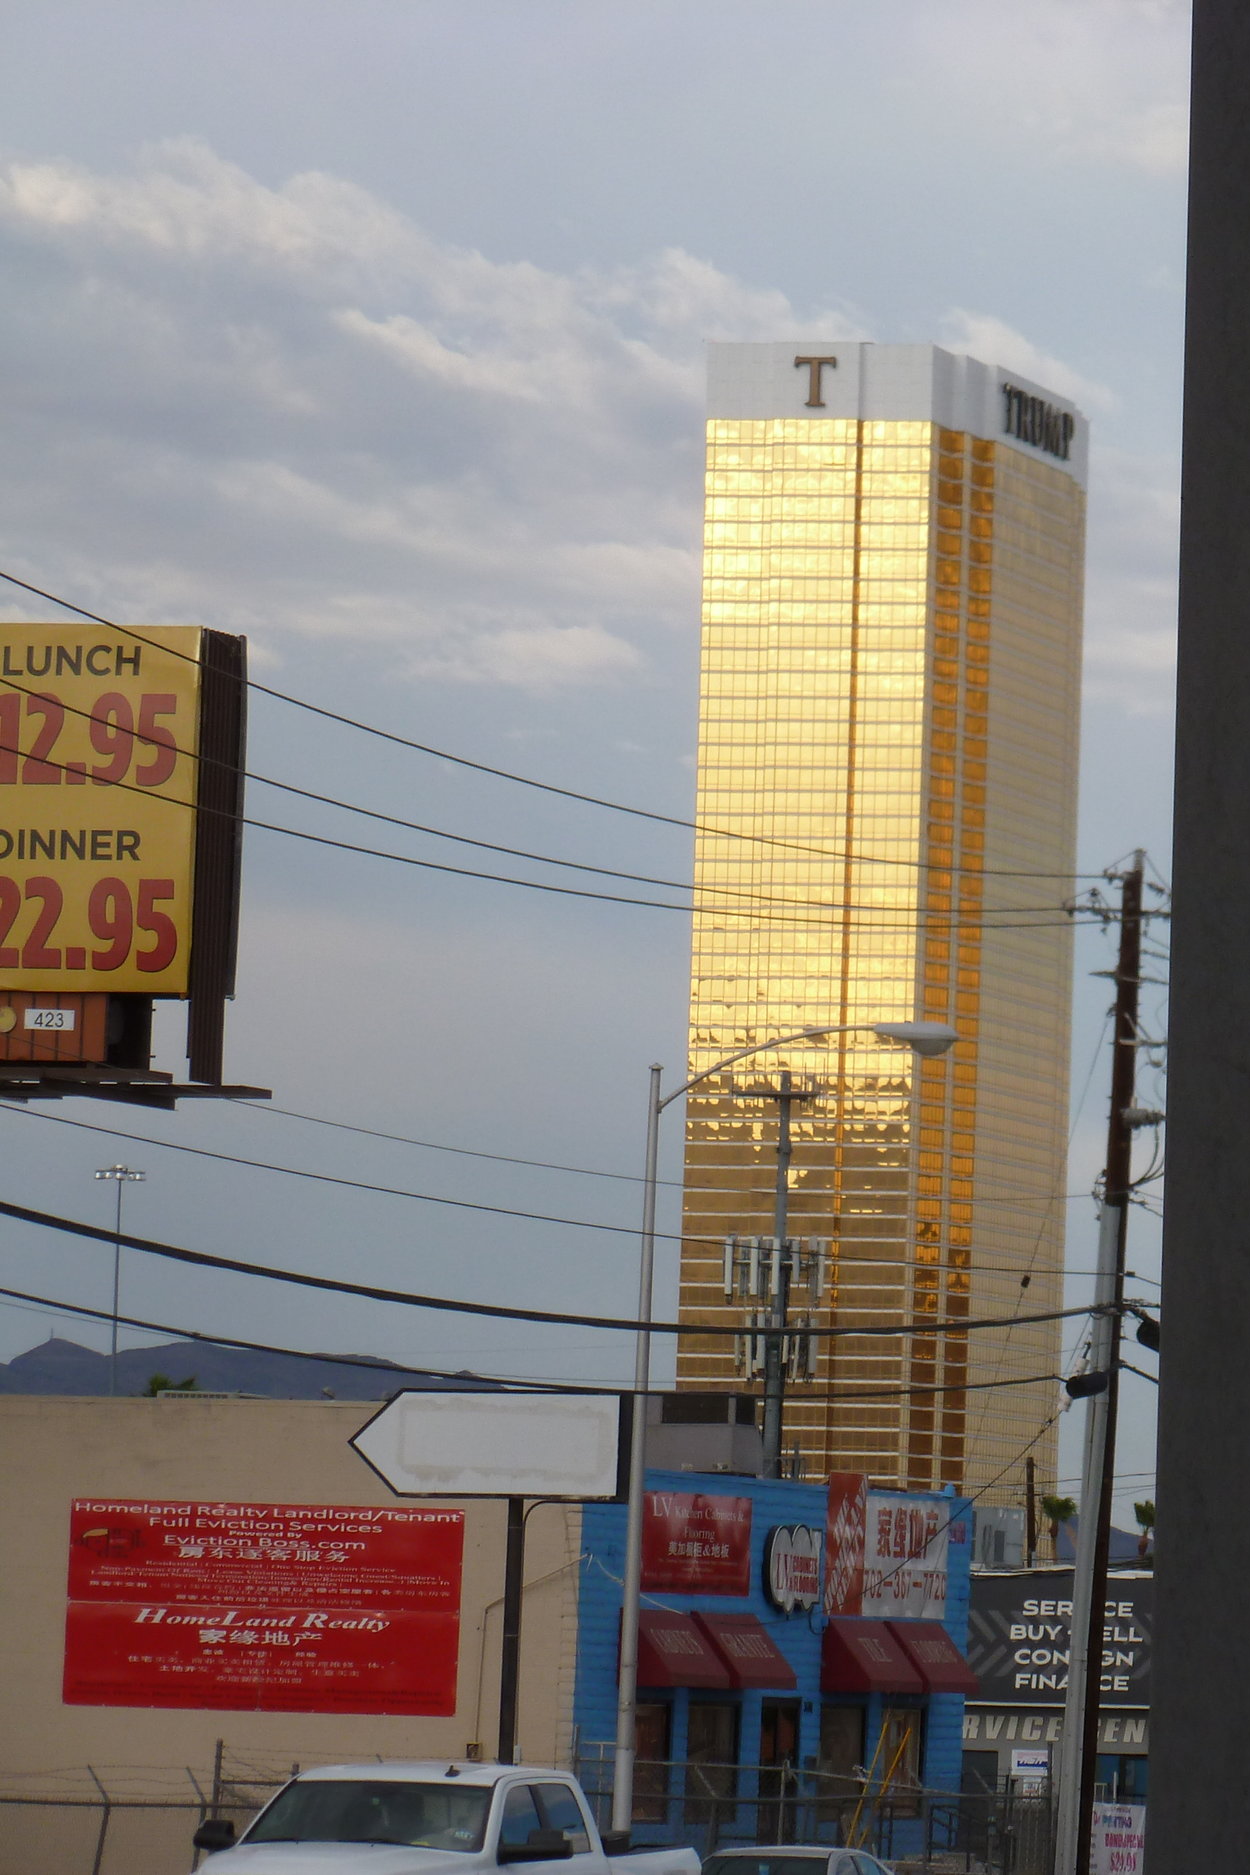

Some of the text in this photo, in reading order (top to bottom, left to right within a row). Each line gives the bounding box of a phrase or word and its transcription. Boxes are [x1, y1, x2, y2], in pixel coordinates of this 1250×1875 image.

[793, 355, 837, 407] T
[1003, 381, 1075, 461] TRUMP
[2, 645, 141, 676] LUNCH
[34, 1012, 64, 1028] 423
[74, 1502, 461, 1523] Homeland Realty Landlord/Tenant
[653, 1496, 673, 1519] LV
[149, 1517, 383, 1534] Full Eviction Services
[229, 1529, 283, 1537] Powered
[164, 1534, 366, 1550] Eviction Boss.com
[1022, 1600, 1134, 1618] SERCE
[134, 1608, 391, 1633] HomeLand Realty
[199, 1629, 323, 1646] 家缘地产
[1010, 1625, 1144, 1643] BUY ELL
[1014, 1648, 1134, 1667] CONGN
[1014, 1674, 1130, 1692] FINACE
[1097, 1717, 1147, 1744] EN
